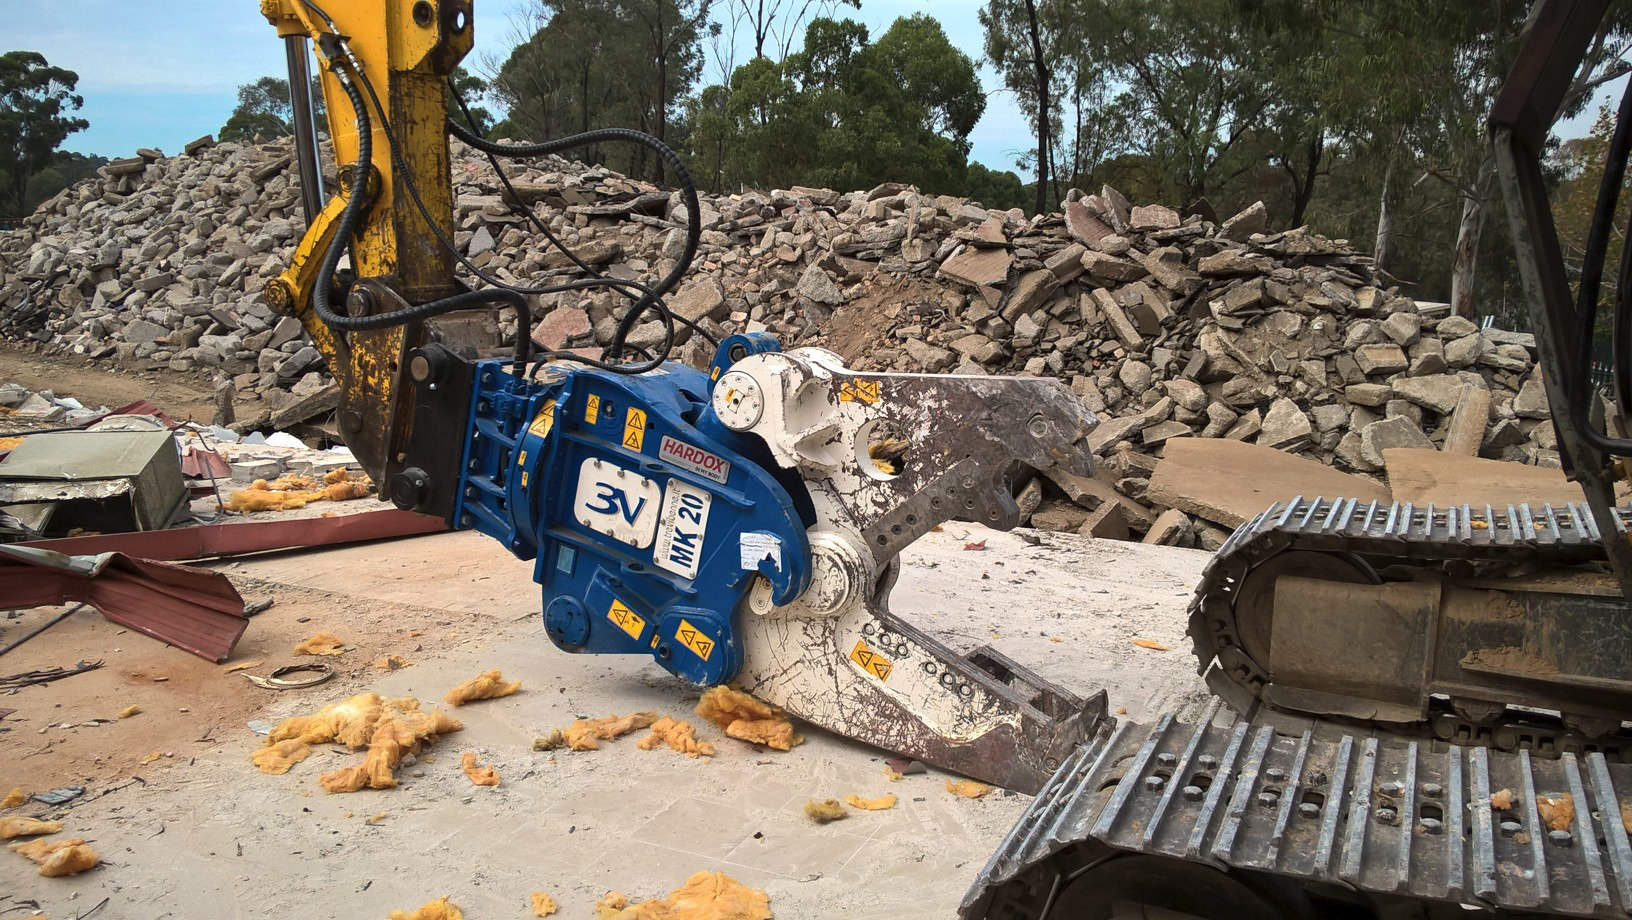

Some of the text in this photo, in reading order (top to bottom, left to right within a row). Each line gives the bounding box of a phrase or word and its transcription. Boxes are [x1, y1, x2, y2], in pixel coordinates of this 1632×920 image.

[663, 438, 725, 474] HARDOX
[708, 471, 721, 480] BODY
[661, 487, 681, 560] www.trevibenne.it
[669, 493, 704, 569] MK 20
